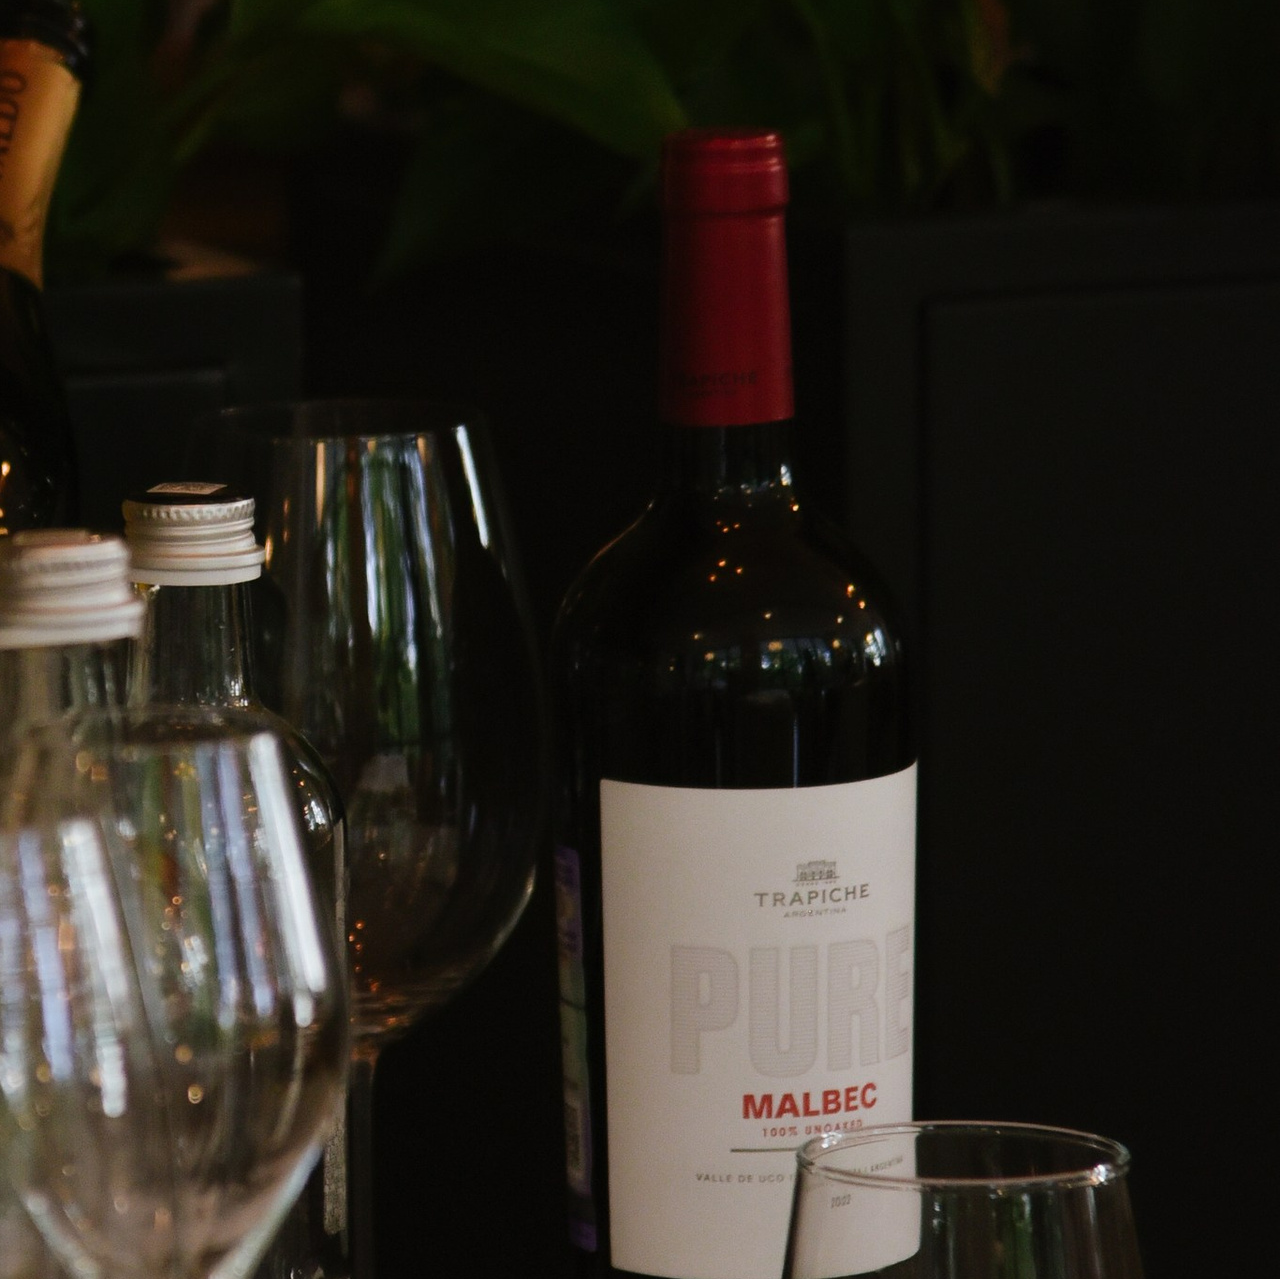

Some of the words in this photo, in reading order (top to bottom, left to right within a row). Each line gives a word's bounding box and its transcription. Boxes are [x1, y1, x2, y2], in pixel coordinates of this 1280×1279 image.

[753, 883, 871, 908] TRAPICHE
[670, 925, 909, 1078] PURE
[741, 1081, 879, 1121] MALBEC
[762, 1125, 799, 1138] 100%
[696, 1172, 732, 1183] VALLE
[738, 1173, 753, 1183] DE
